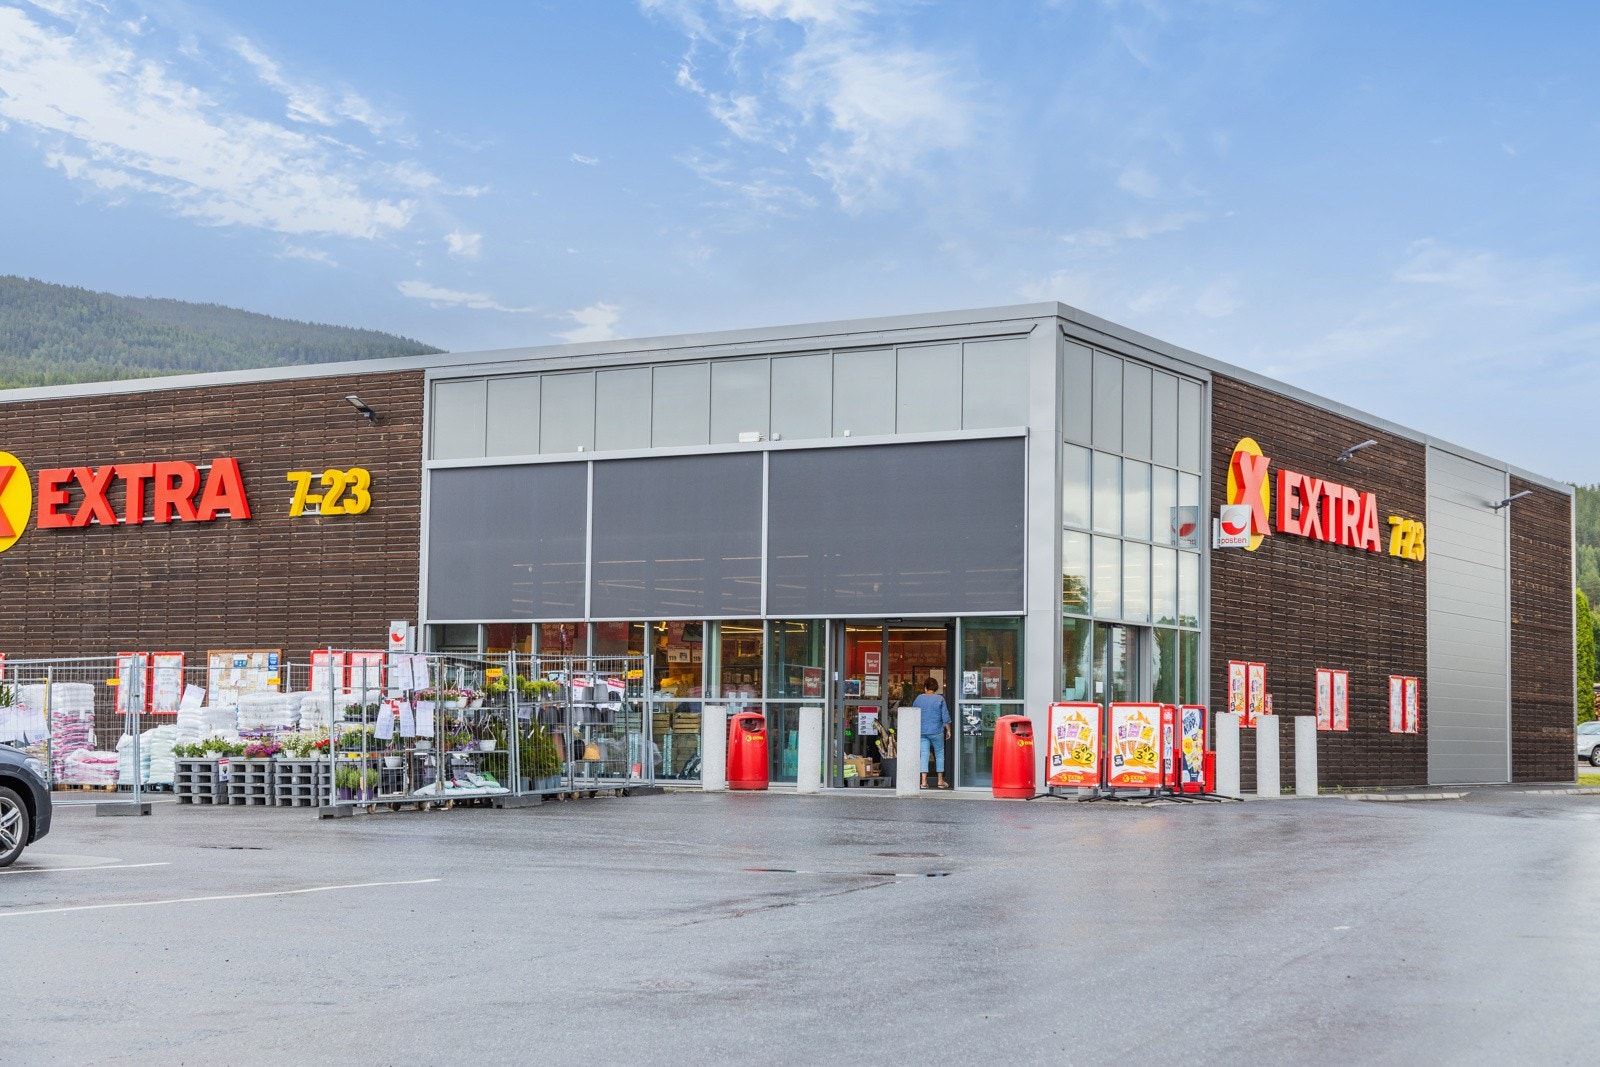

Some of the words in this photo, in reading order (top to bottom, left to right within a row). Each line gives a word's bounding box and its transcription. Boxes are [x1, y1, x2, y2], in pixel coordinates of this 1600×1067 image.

[37, 457, 252, 529] EXTRA
[286, 467, 372, 517] 7-23
[1276, 469, 1382, 552] EXTRA
[1388, 515, 1425, 562] 7-23
[1221, 536, 1247, 546] posten
[1074, 750, 1081, 760] 3
[1085, 752, 1093, 762] 2
[1136, 750, 1143, 760] 3
[1148, 752, 1155, 762] 2
